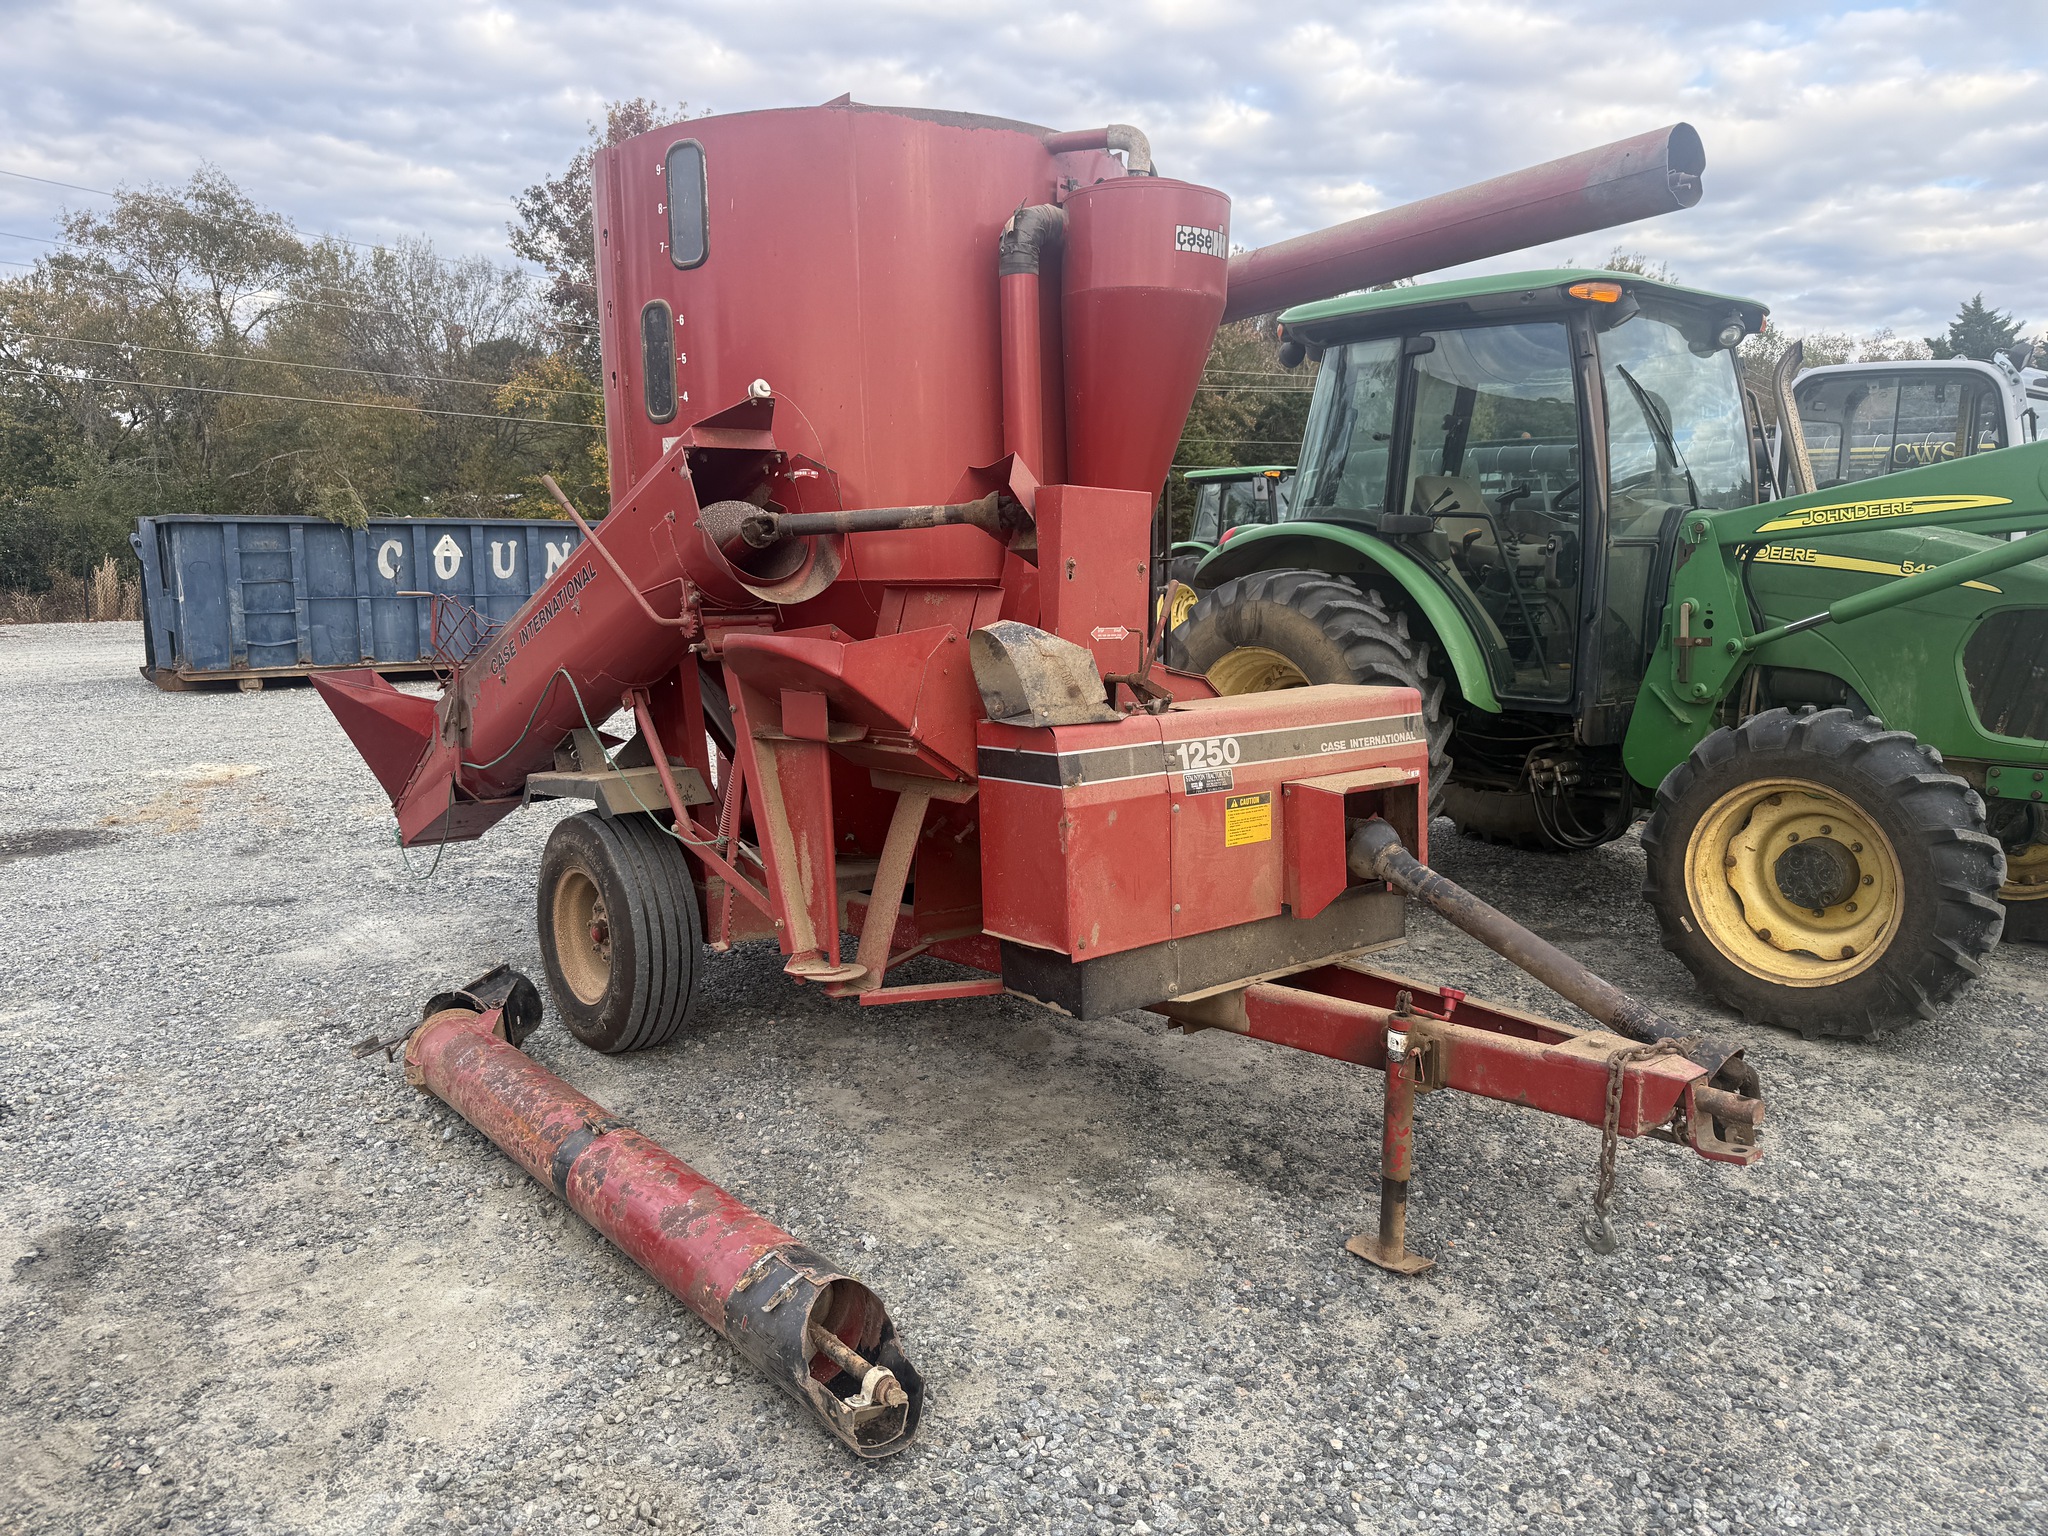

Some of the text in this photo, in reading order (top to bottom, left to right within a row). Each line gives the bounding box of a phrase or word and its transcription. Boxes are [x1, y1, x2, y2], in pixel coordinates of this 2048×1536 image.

[1802, 501, 1914, 525] JOHN DEERE
[1902, 560, 1937, 574] 54
[491, 560, 597, 675] CASE INTERNATIONAL
[1320, 731, 1416, 752] CASE INTERNATIONAL
[1176, 738, 1241, 770] 1250
[1239, 795, 1260, 806] CAUTION
